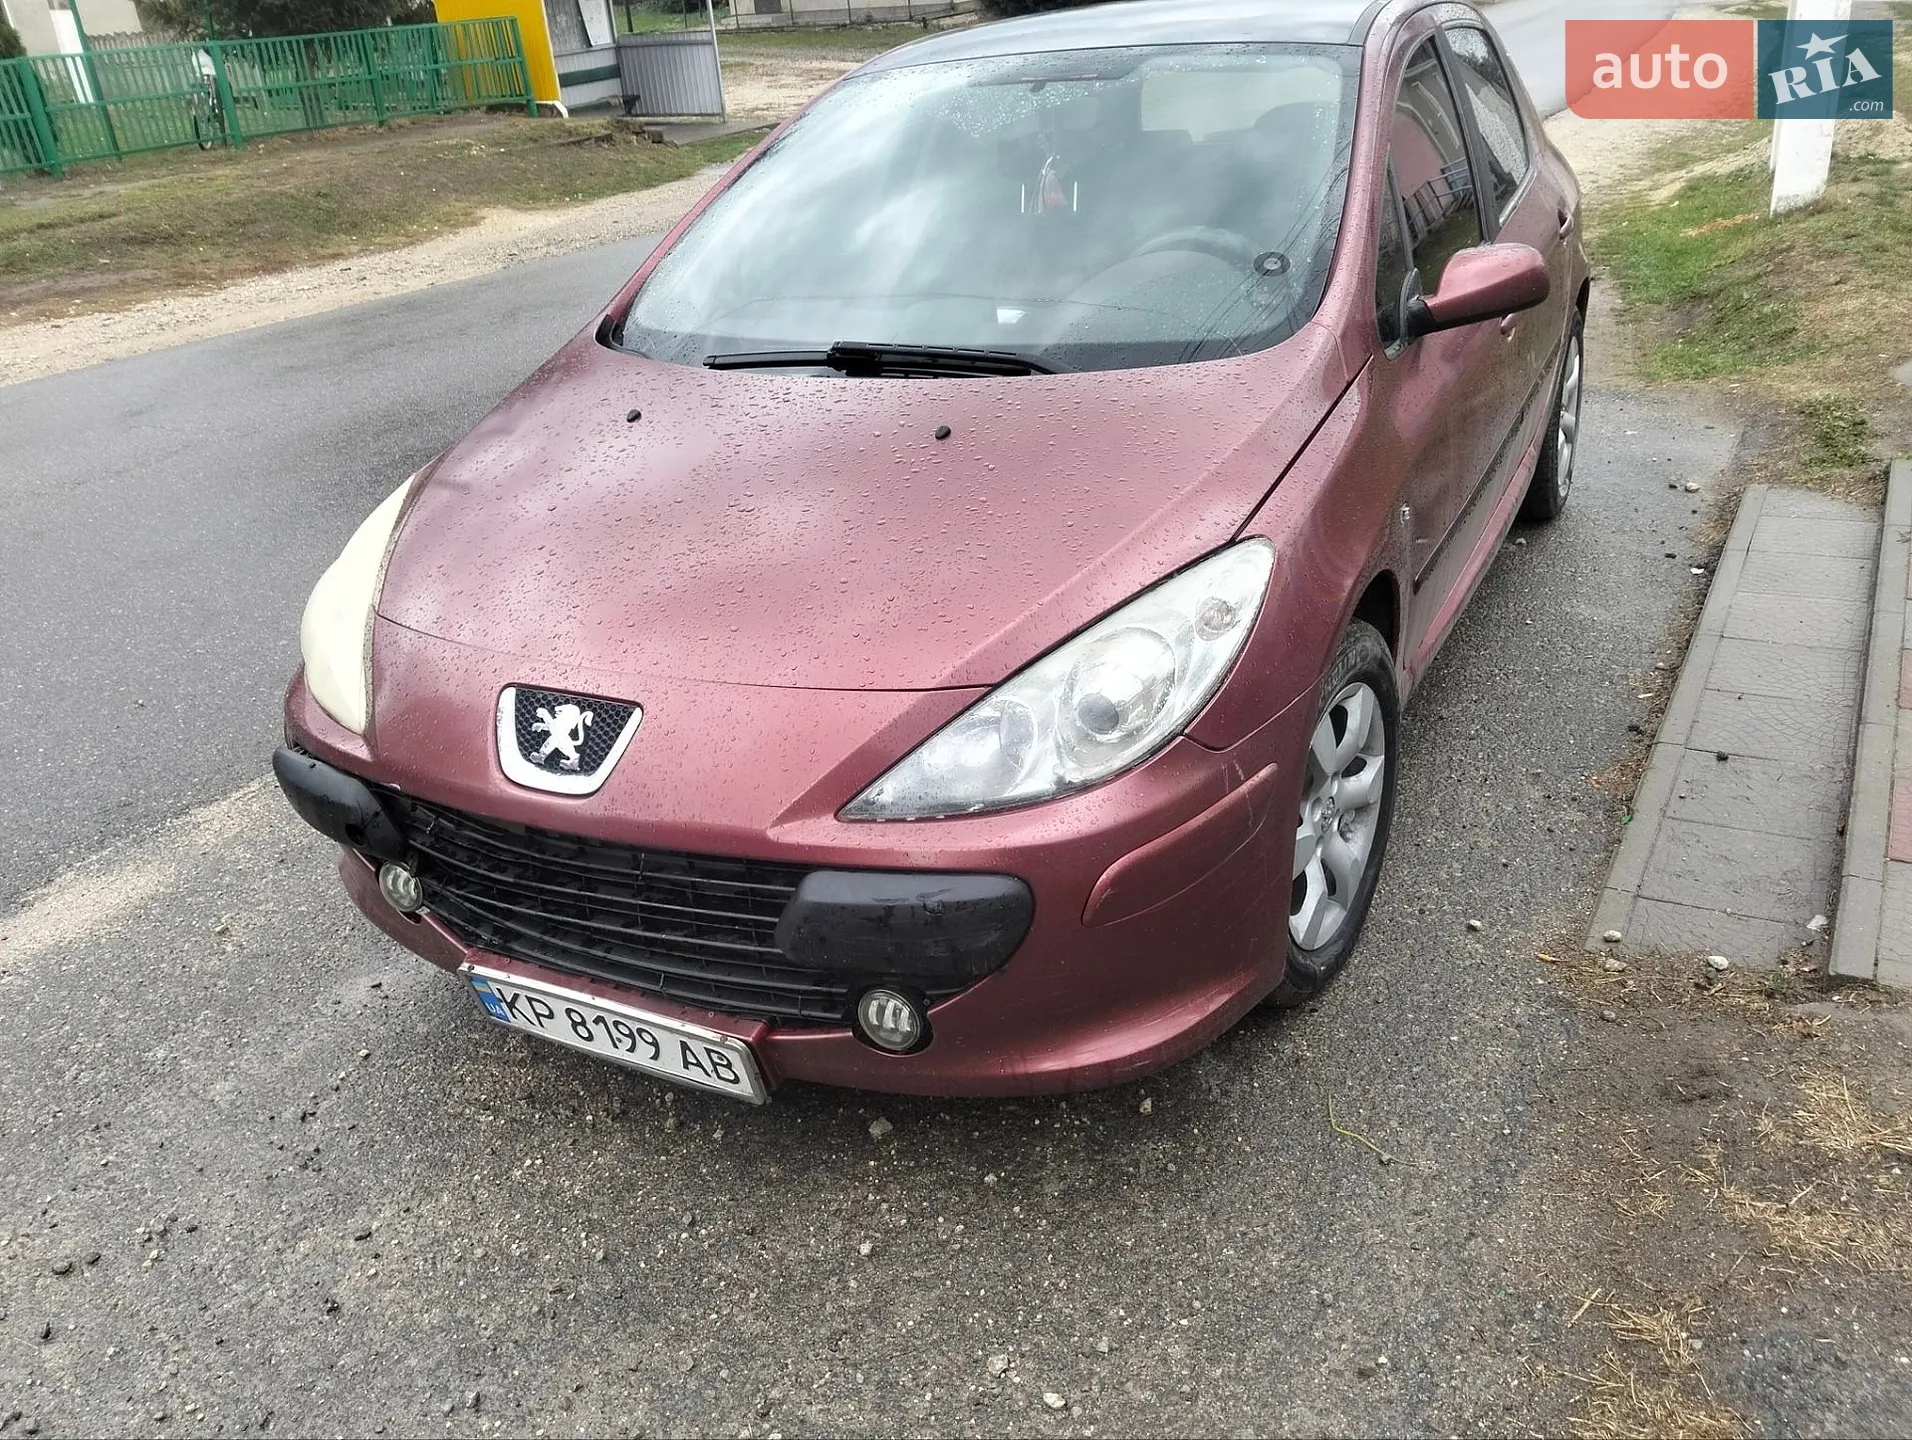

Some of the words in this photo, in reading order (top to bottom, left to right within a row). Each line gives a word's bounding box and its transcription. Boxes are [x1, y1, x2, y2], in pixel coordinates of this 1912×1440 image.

[486, 1002, 506, 1017] UA
[495, 987, 555, 1029] KP
[564, 1007, 661, 1061] 8199
[678, 1039, 741, 1085] AB
